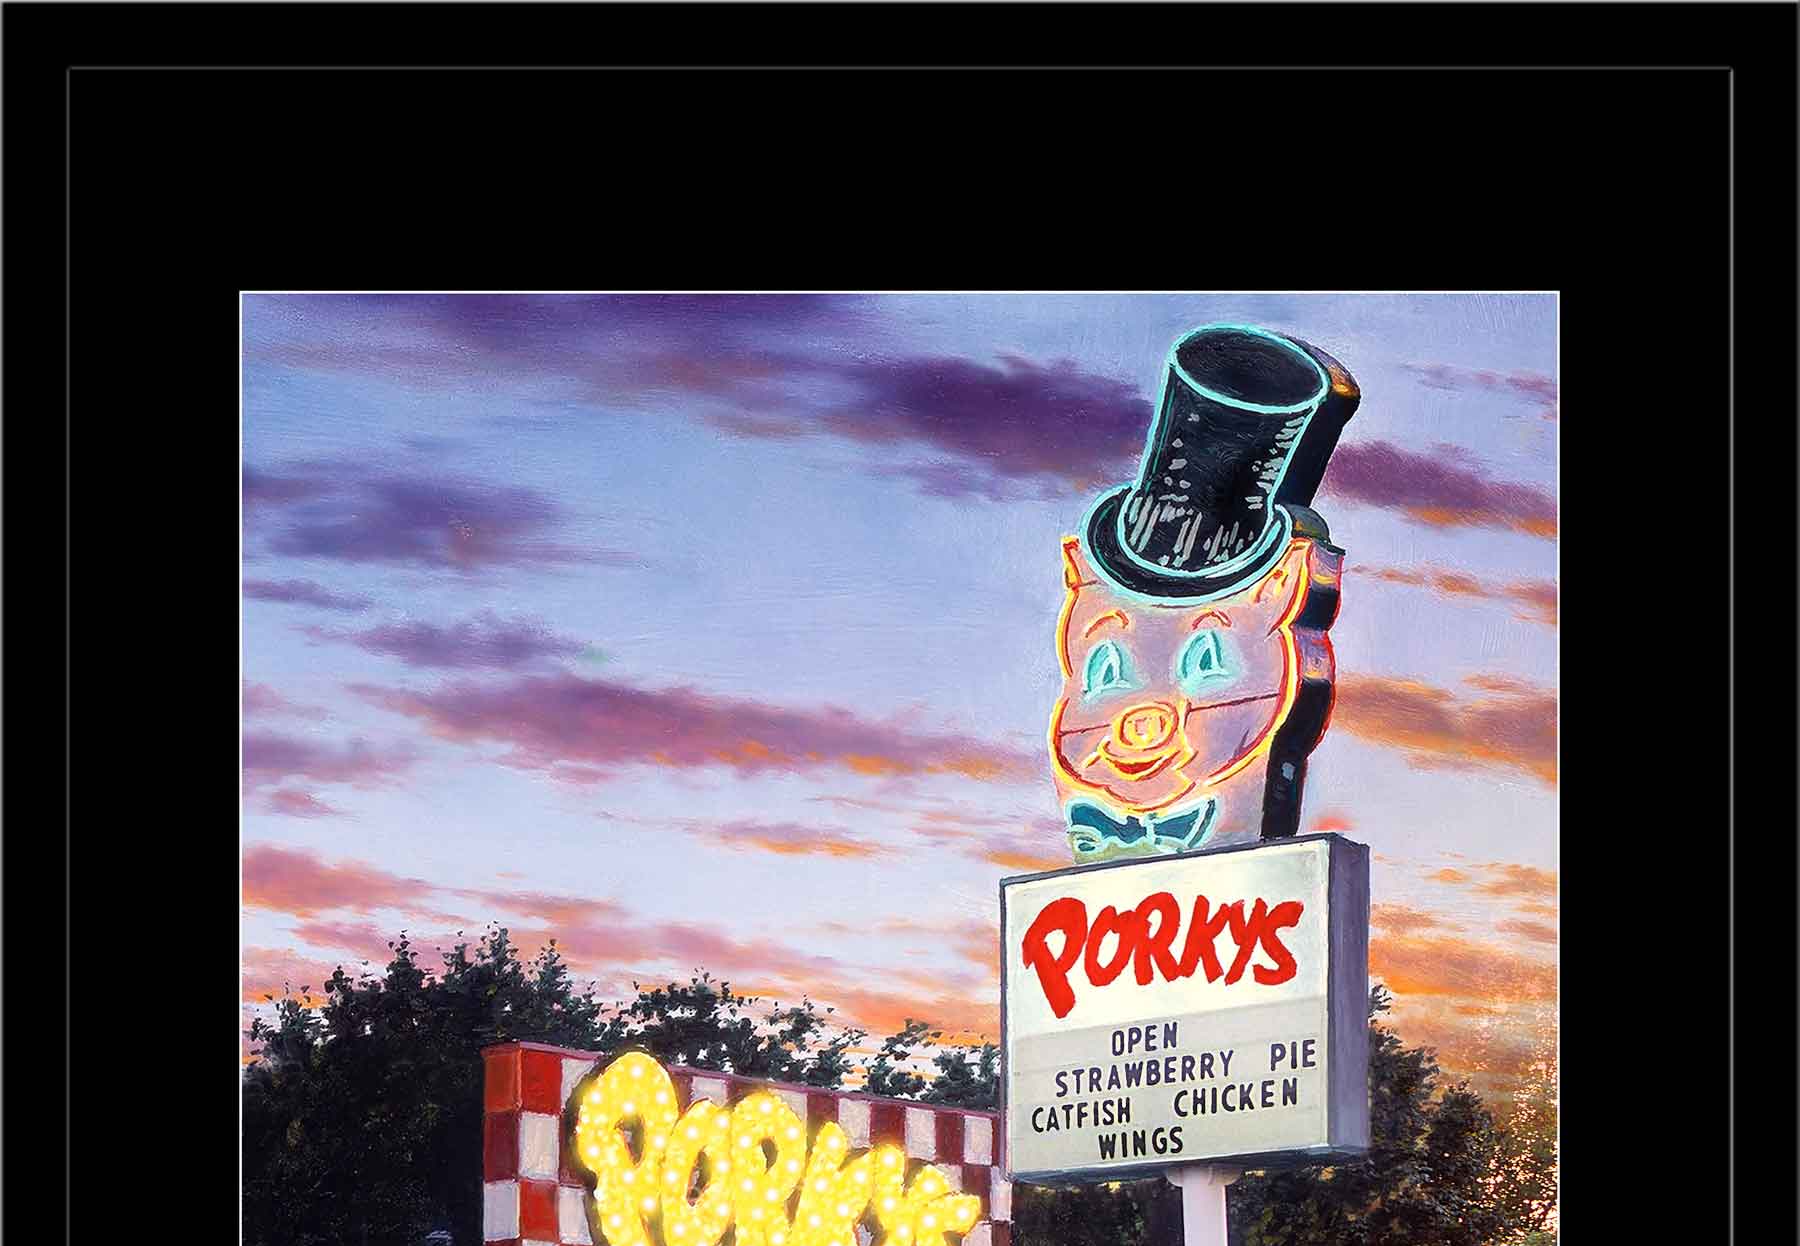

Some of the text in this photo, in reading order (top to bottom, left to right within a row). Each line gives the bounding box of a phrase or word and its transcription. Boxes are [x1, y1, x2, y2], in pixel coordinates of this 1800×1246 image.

[1022, 891, 1304, 1019] PORKYS
[1111, 1021, 1178, 1056] OPEN
[1055, 1039, 1317, 1097] STRAWBERRY PIE
[1032, 1077, 1299, 1133] CATFISH CHICKEN
[1098, 1126, 1184, 1160] WINGS
